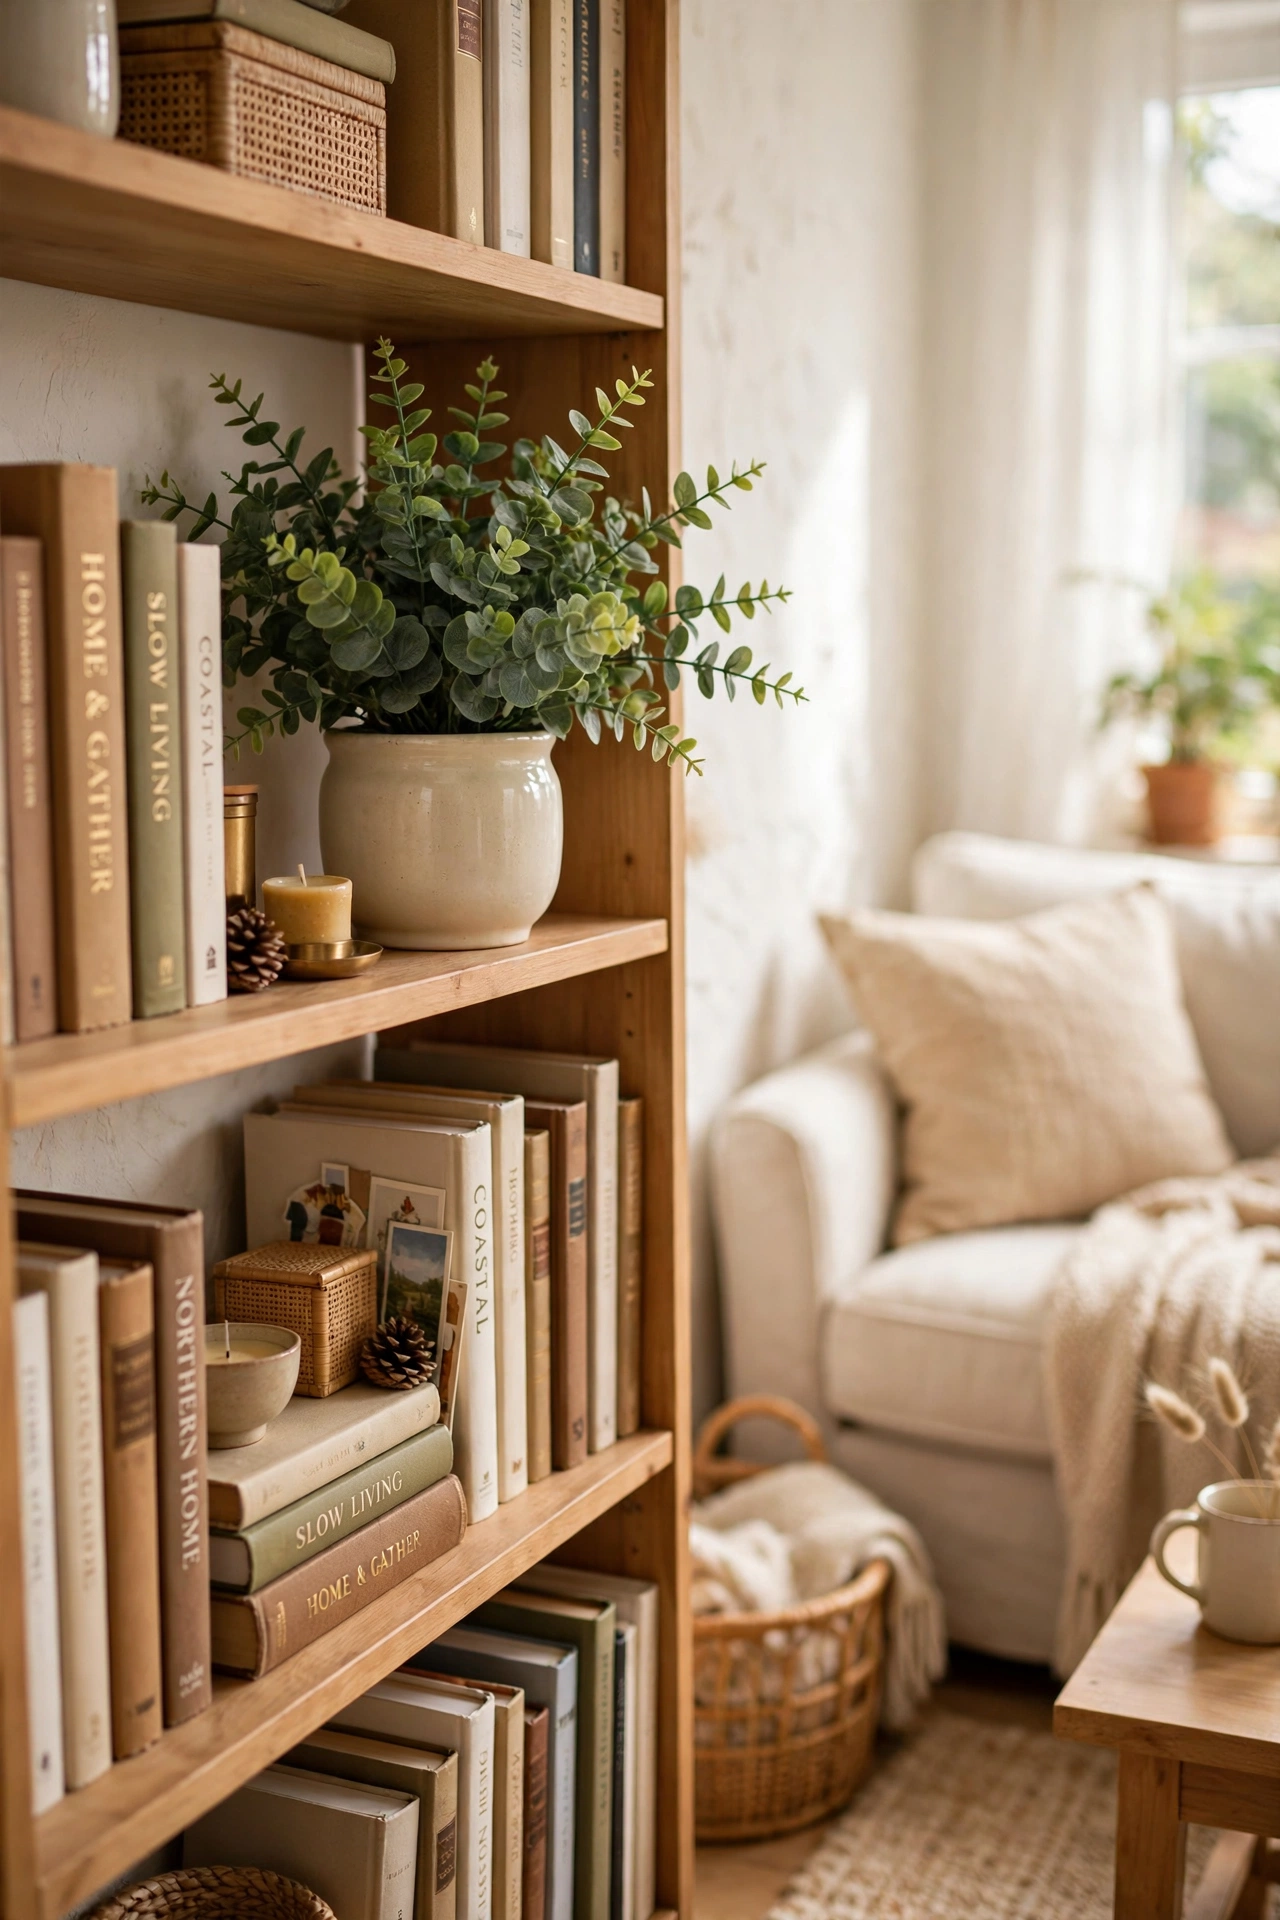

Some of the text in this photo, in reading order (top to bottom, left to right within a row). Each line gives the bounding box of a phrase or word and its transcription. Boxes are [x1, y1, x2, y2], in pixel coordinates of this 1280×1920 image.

[80, 553, 114, 895] HOME & GATHER
[147, 592, 172, 823] SLOW LIVING
[199, 635, 215, 777] COASTAL
[473, 1184, 489, 1335] COASTAL
[175, 1274, 200, 1570] NORTHERN HOME
[296, 1470, 403, 1549] SLOW LIVING
[306, 1529, 422, 1619] HOME & GATHER
